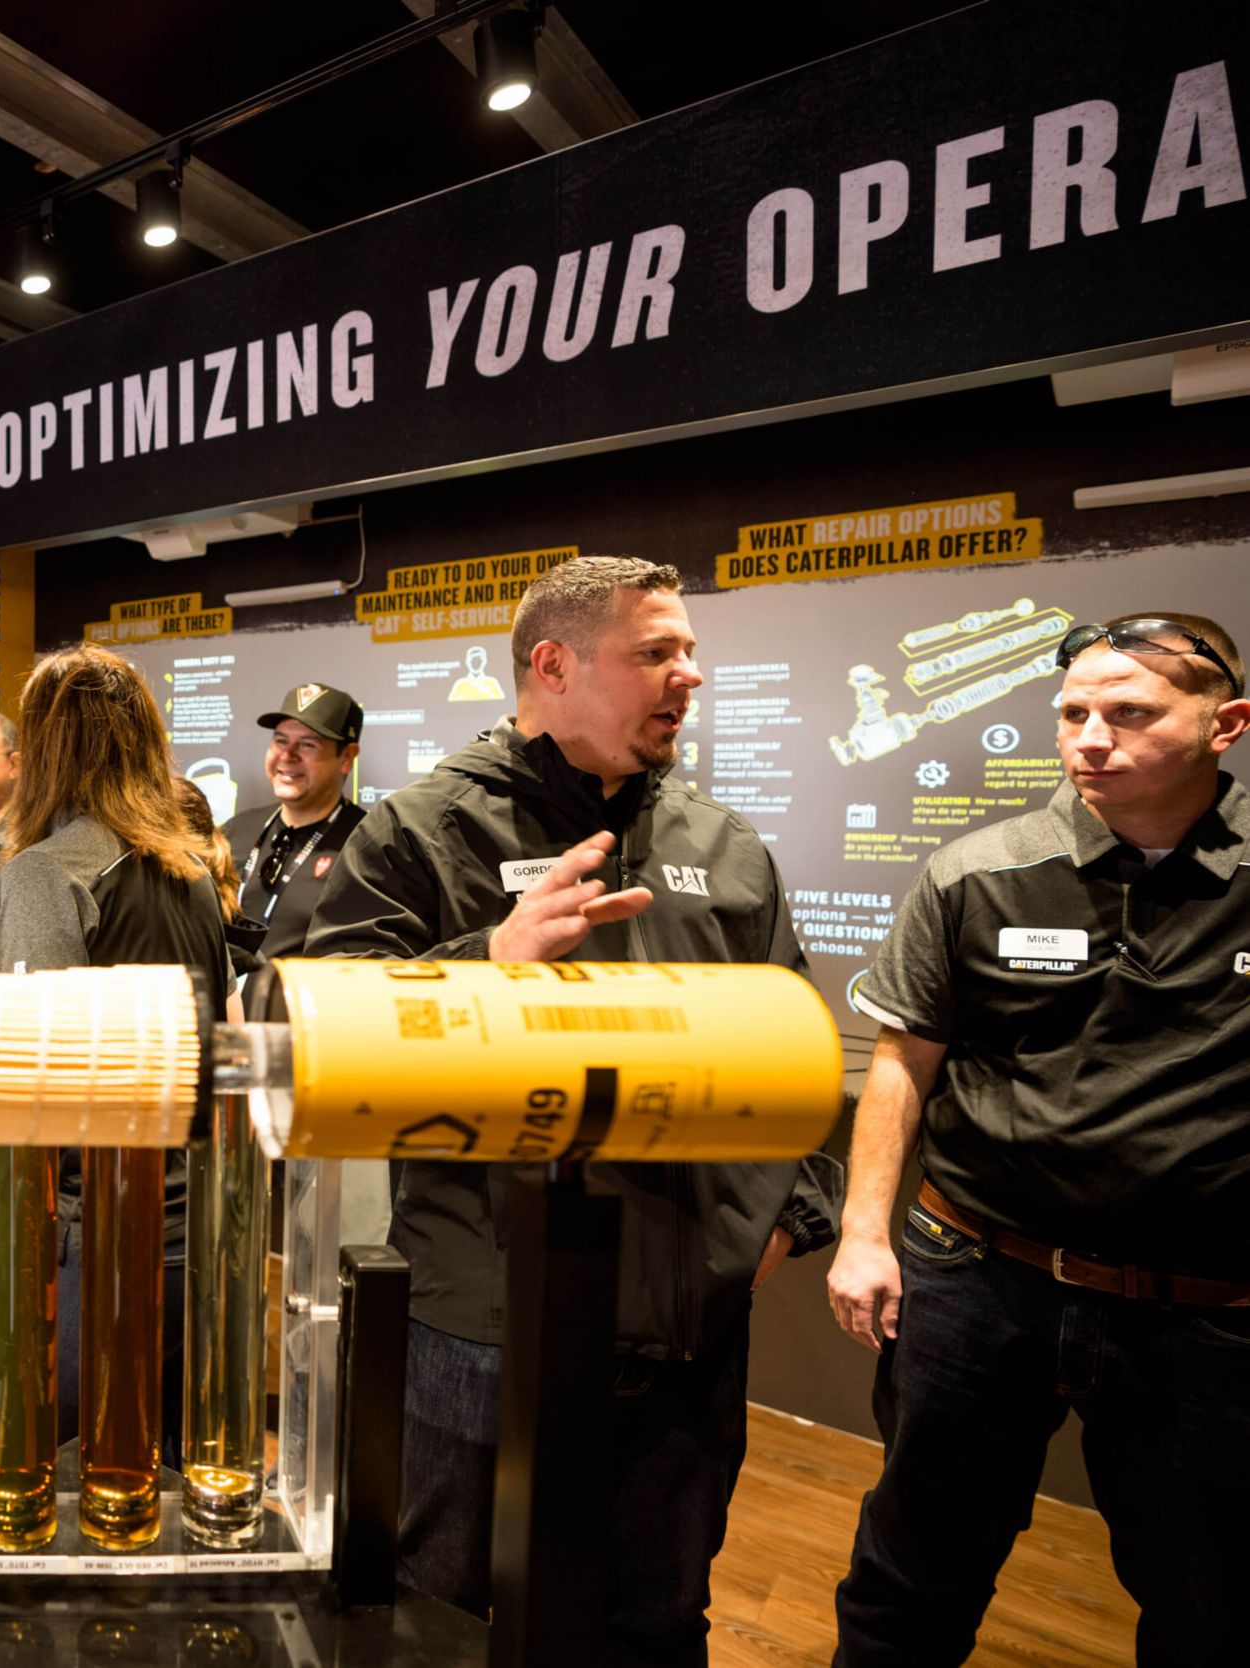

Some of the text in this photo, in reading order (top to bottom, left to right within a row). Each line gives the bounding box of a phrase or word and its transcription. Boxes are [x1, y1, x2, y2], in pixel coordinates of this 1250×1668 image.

[425, 224, 687, 390] YOUR
[750, 500, 1003, 550] WHAT REPAIR OPTIONS
[729, 527, 1028, 580] DOES CATERPILLAR OFFER?
[394, 570, 439, 589] READY
[443, 566, 460, 583] TO
[466, 563, 486, 581] DO
[491, 557, 531, 578] YOUR
[362, 579, 534, 614] MAINTENANCE AND REP
[120, 597, 192, 619] WHAT TYPE OF
[412, 604, 512, 633] SELF-SERVICE
[117, 619, 160, 639] OPTIONS
[162, 617, 182, 633] ARE
[185, 613, 225, 632] THERE?
[985, 758, 1061, 768] AFFORDABILITY
[984, 770, 1004, 779] your
[984, 779, 1059, 789] regard to price?
[913, 796, 971, 805] UTILIZATION
[975, 797, 995, 806] How
[913, 807, 935, 815] often
[938, 807, 949, 815] do
[951, 808, 967, 817] you
[913, 816, 969, 826] the machine?
[845, 833, 941, 845] OWNERSHIP How long
[845, 843, 902, 853] do you plan to
[863, 853, 877, 861] the
[878, 853, 918, 862] machine?
[662, 864, 710, 897] CAT
[794, 890, 829, 904] FIVE
[833, 891, 892, 908] LEVELS
[793, 908, 847, 921] options
[1026, 934, 1060, 944] MIKE
[809, 940, 867, 956] choose.
